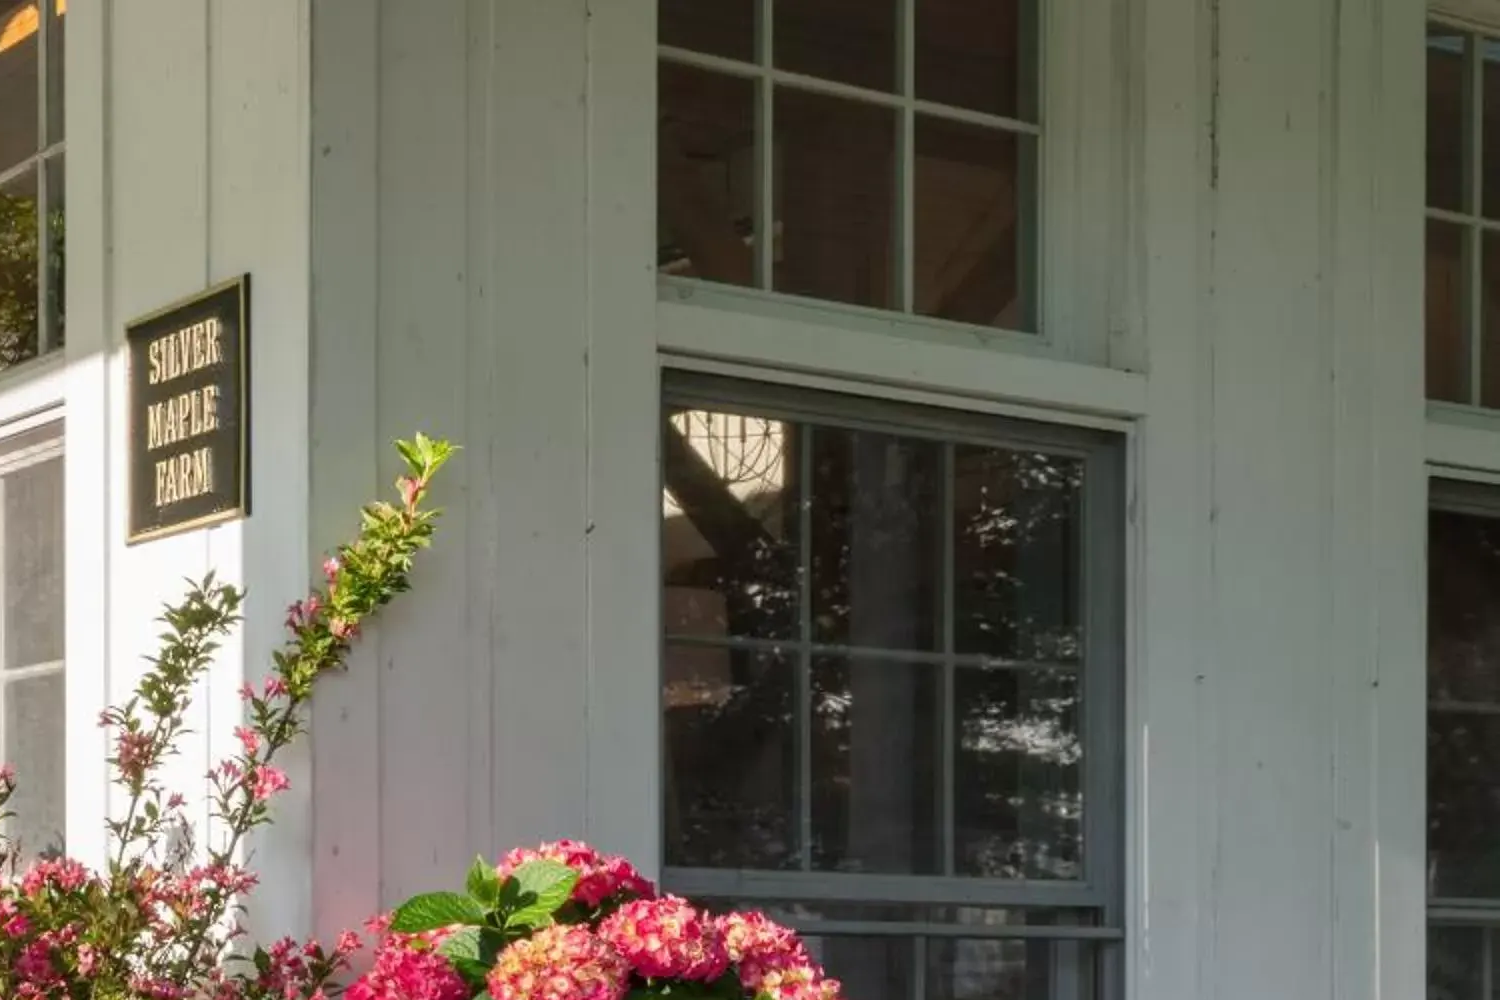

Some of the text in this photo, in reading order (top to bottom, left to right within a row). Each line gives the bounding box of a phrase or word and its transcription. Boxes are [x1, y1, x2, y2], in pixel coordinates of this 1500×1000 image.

[148, 317, 222, 385] SILVER
[147, 385, 220, 450] MAPLE
[155, 447, 213, 507] FARM
